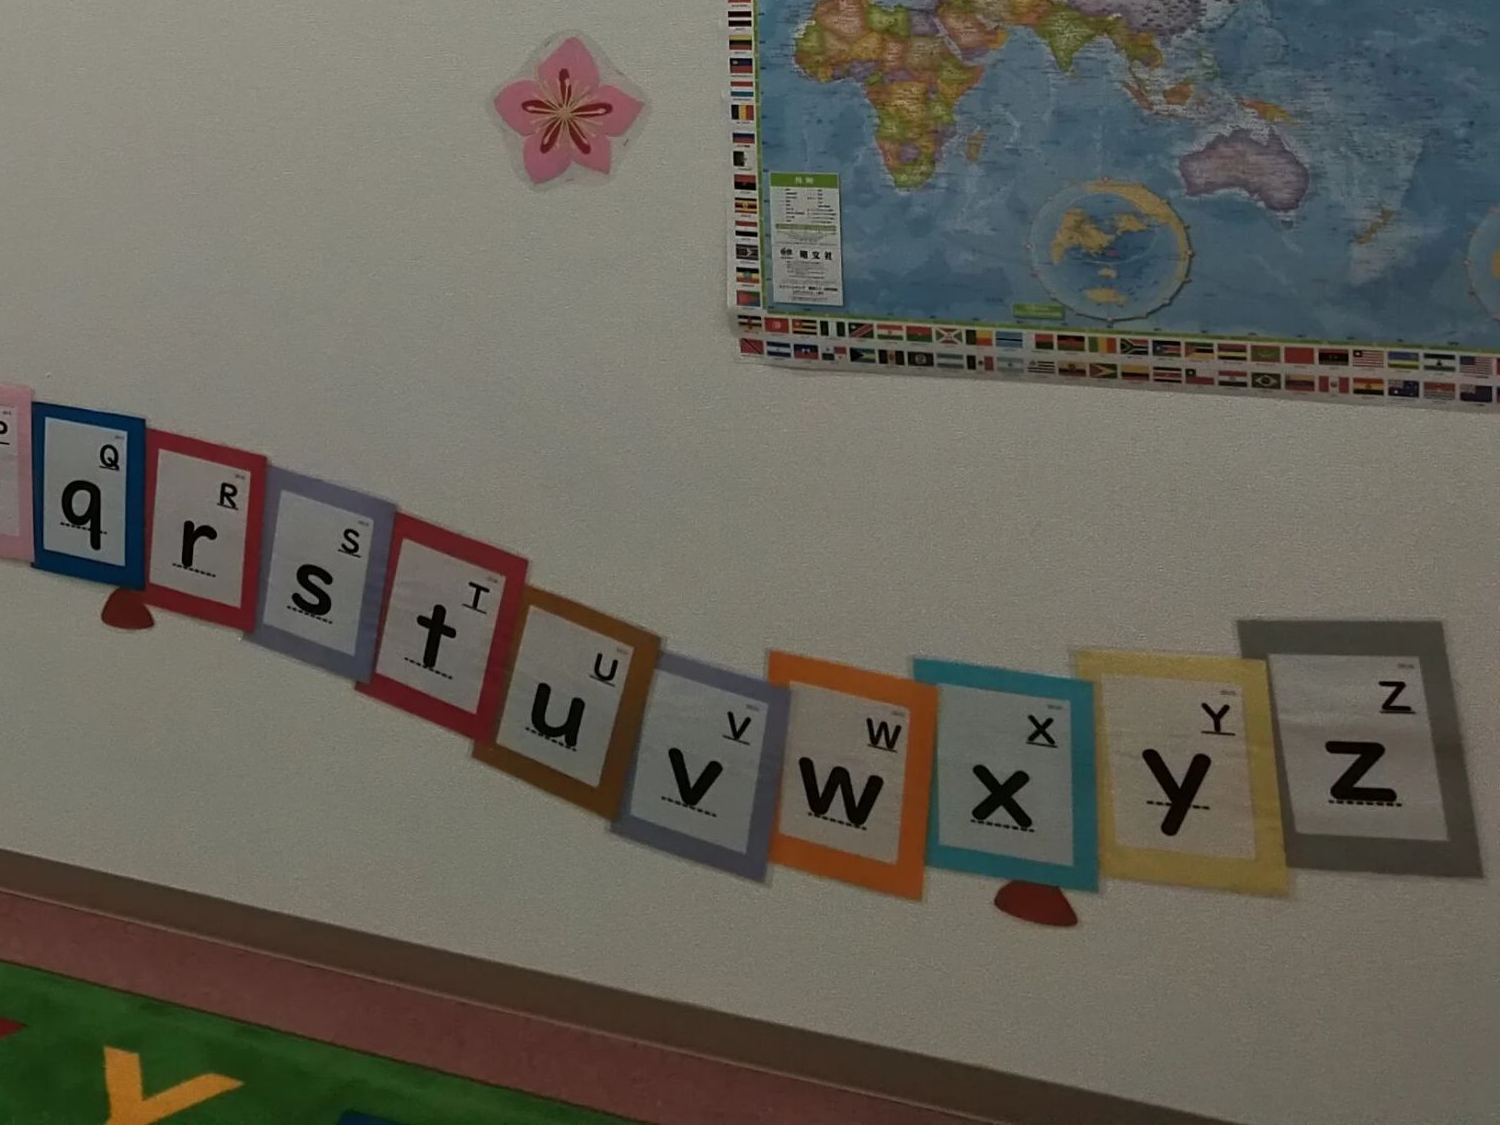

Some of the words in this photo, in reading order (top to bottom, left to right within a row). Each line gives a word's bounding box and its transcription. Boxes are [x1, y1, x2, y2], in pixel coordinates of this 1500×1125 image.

[100, 444, 119, 469] Q
[61, 479, 101, 551] q
[219, 482, 238, 509] R
[182, 520, 217, 568] r
[341, 528, 360, 555] S
[291, 563, 334, 616] s
[468, 581, 490, 611] T
[416, 604, 457, 669] t
[593, 653, 619, 682] U
[530, 682, 586, 747] u
[1378, 681, 1412, 711] Z
[727, 711, 751, 740] V
[866, 717, 902, 750] W
[1027, 714, 1055, 745] X
[1201, 702, 1230, 733] Y
[667, 747, 723, 806] v
[799, 756, 884, 826] w
[1325, 740, 1398, 802] z
[971, 764, 1033, 828] x
[1142, 748, 1212, 836] y
